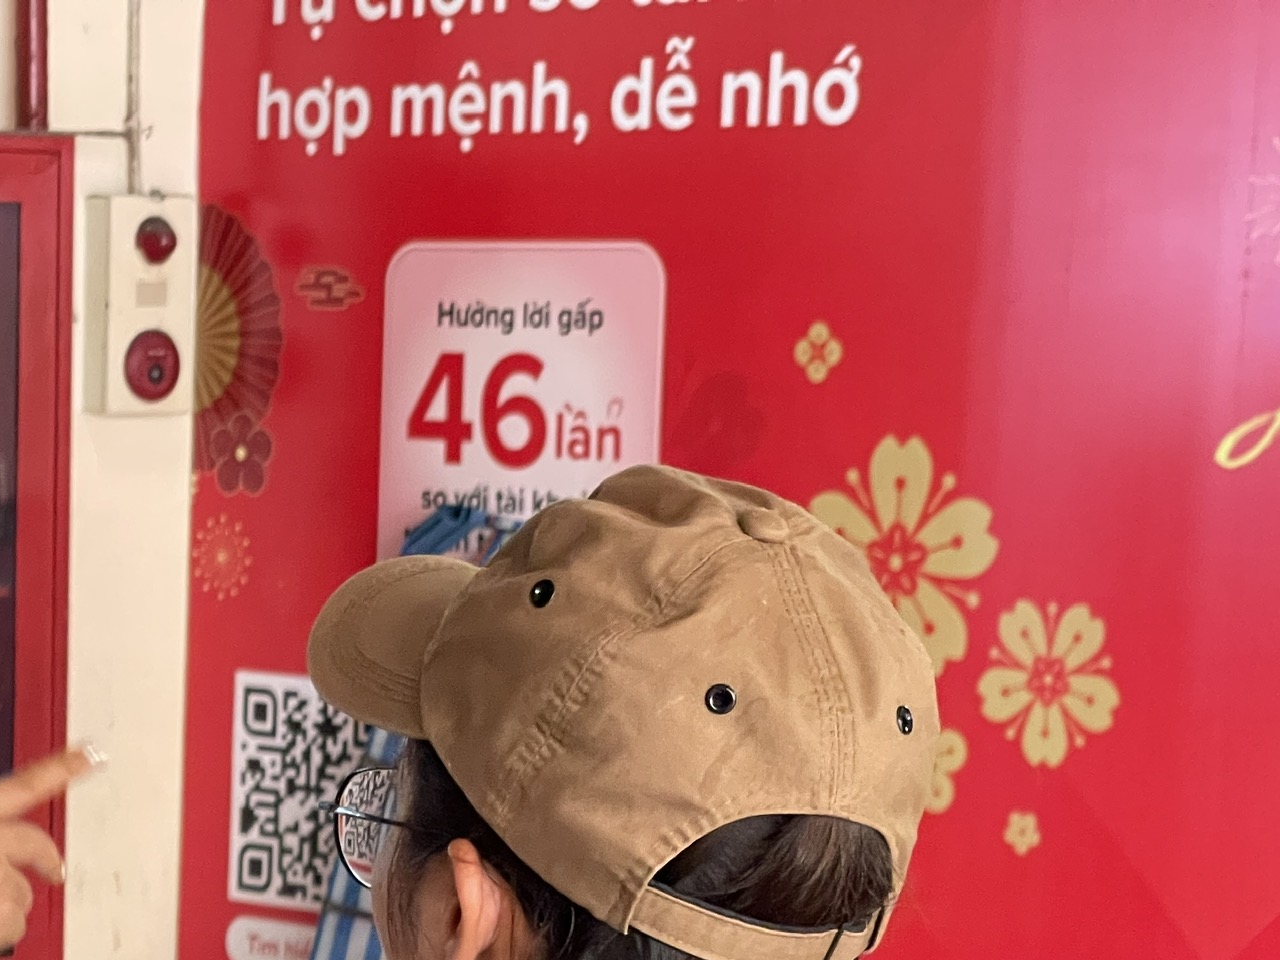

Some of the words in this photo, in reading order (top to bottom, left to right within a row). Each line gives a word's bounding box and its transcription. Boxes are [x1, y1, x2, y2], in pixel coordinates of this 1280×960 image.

[256, 75, 371, 156] hợp
[389, 60, 589, 154] mệnh,
[609, 35, 697, 132] dễ
[720, 44, 862, 128] nhớ
[436, 300, 515, 336] Hưởng
[522, 300, 551, 330] lời
[558, 296, 605, 337] gấp
[407, 351, 548, 472] 46
[554, 403, 623, 463] lần
[421, 490, 448, 511] so
